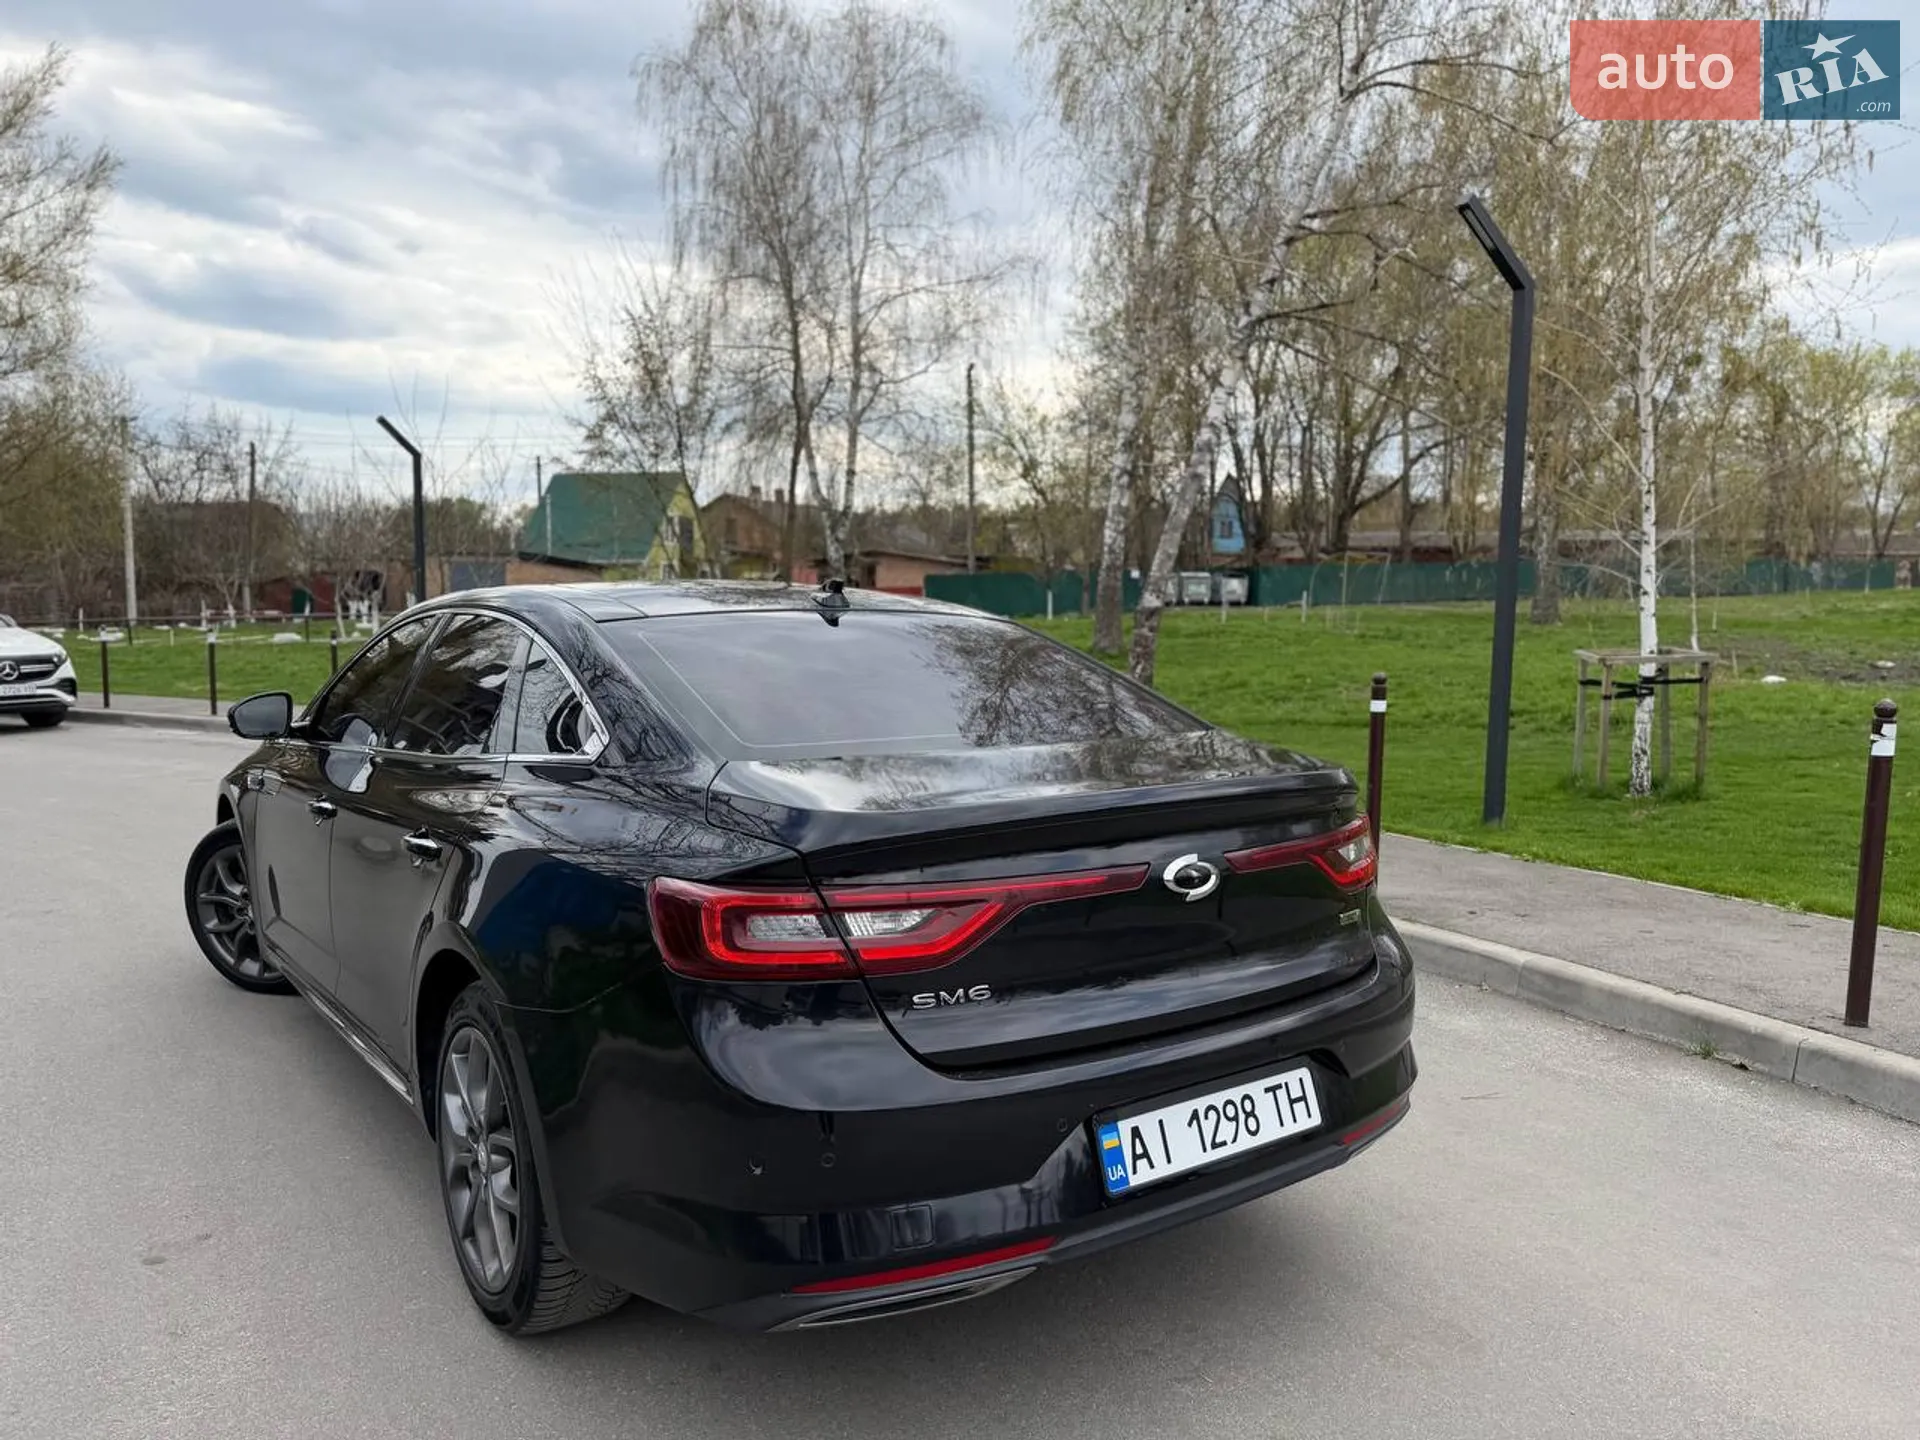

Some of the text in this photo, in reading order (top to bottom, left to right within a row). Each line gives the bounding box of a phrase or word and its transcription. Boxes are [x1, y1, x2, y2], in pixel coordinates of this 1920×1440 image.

[912, 984, 992, 1009] SM6
[1130, 1077, 1312, 1175] AI 1298 TH
[1108, 1164, 1126, 1181] UA
